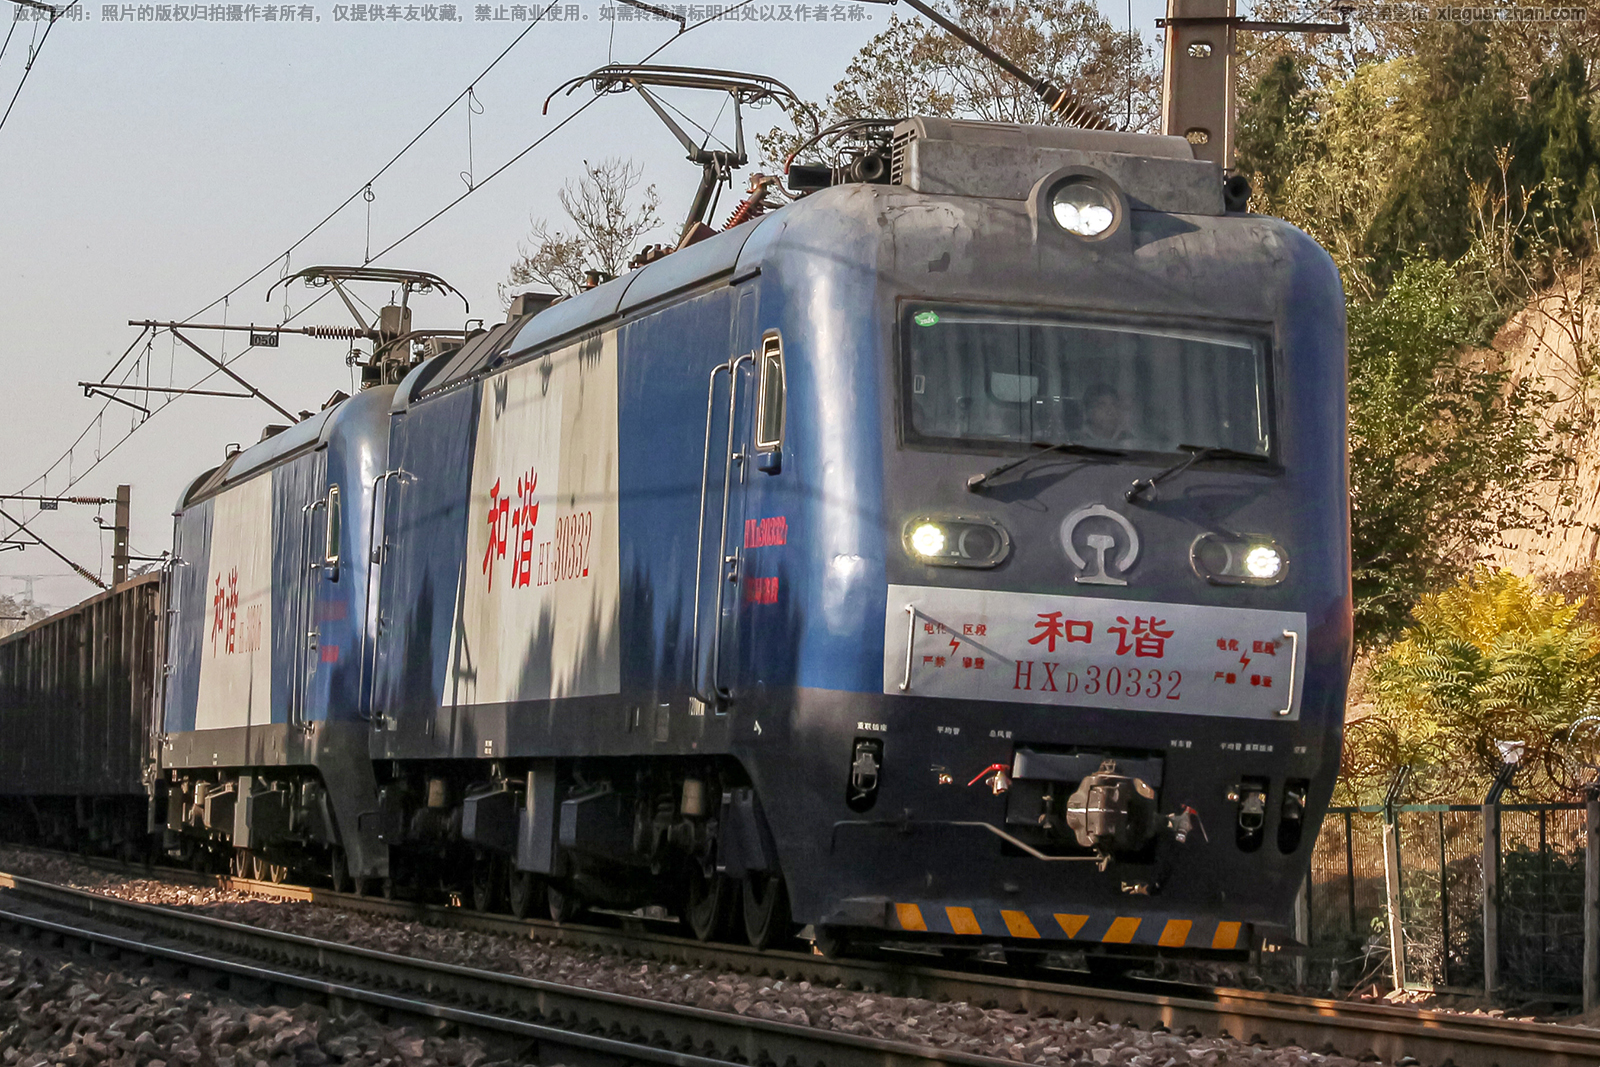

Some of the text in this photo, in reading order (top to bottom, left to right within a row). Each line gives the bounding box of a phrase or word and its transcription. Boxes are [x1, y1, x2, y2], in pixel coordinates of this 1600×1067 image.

[254, 335, 276, 346] 050
[482, 466, 540, 594] 和谐
[211, 565, 239, 659] 和谐
[1028, 611, 1175, 659] 和谐
[1012, 659, 1182, 700] HXD30332
